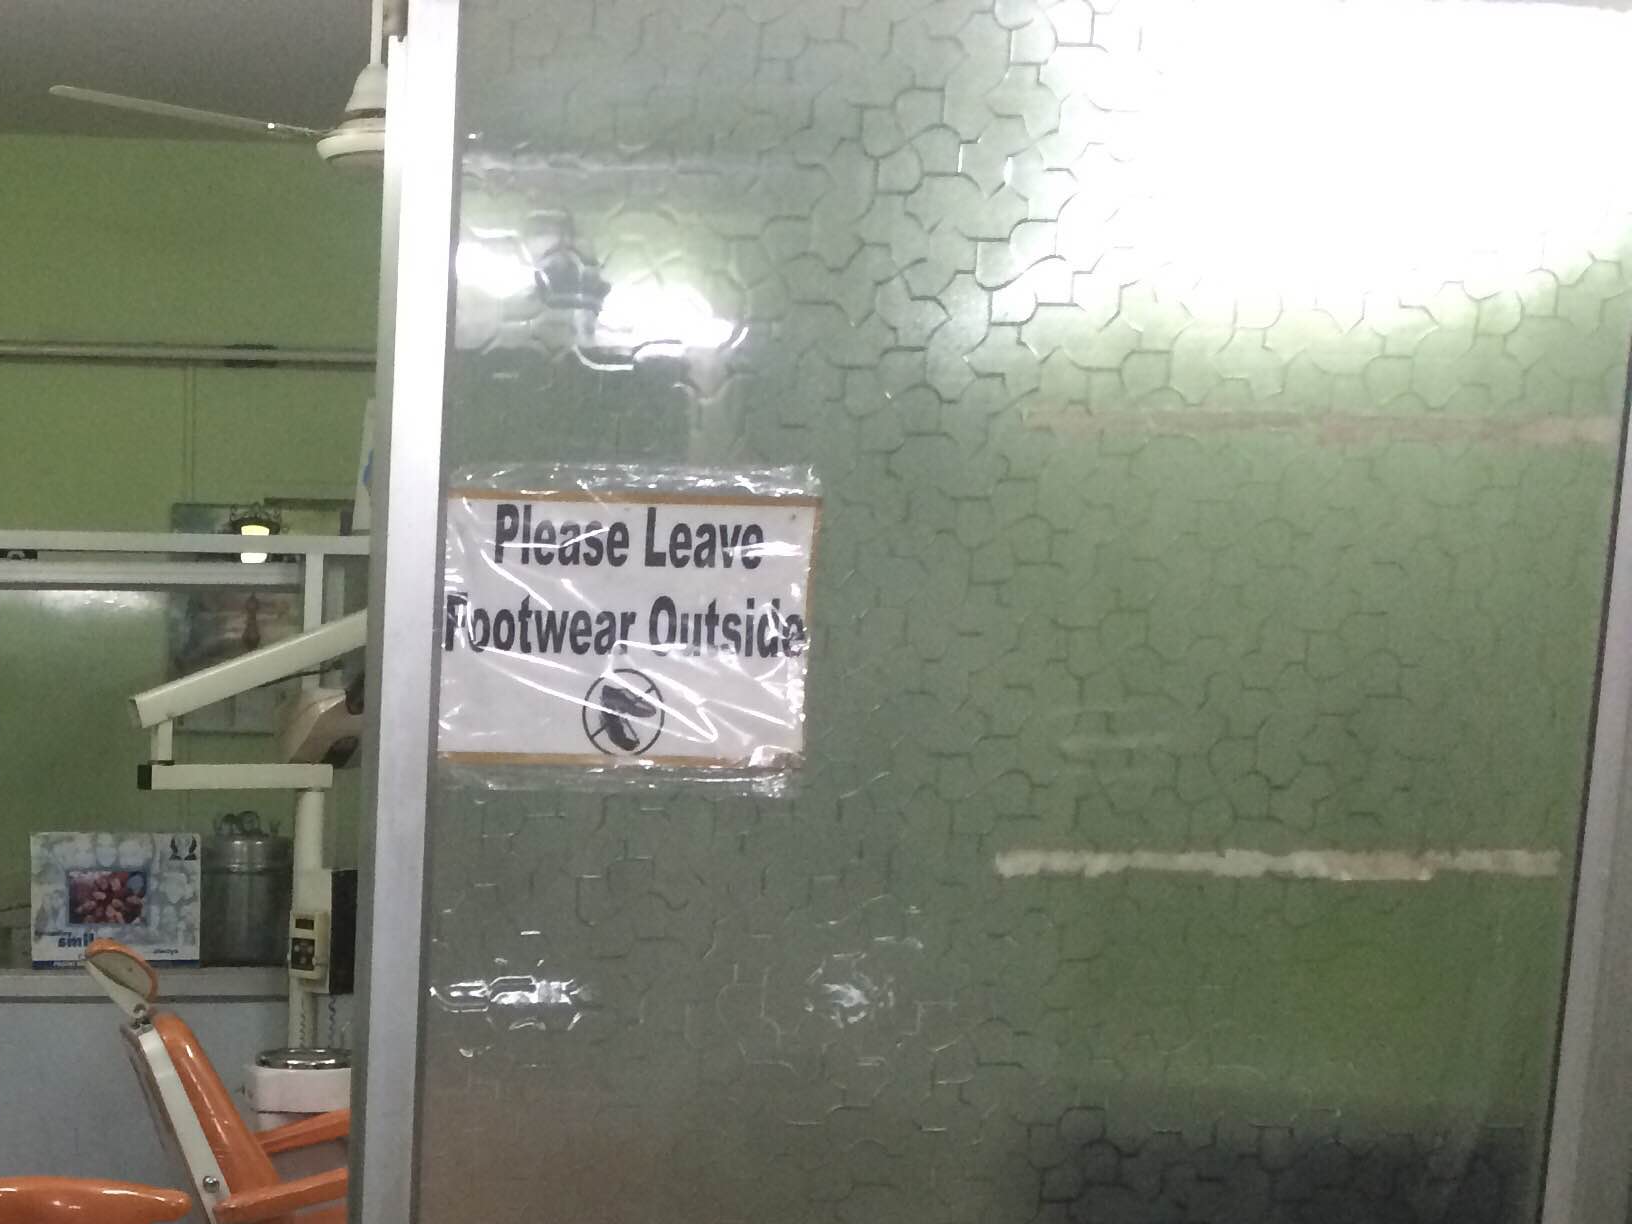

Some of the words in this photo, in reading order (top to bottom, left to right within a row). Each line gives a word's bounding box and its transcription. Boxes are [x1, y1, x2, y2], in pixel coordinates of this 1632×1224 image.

[494, 503, 630, 567] Please
[644, 506, 764, 570] Leave
[445, 592, 637, 655] Footwear
[649, 595, 806, 658] Outside
